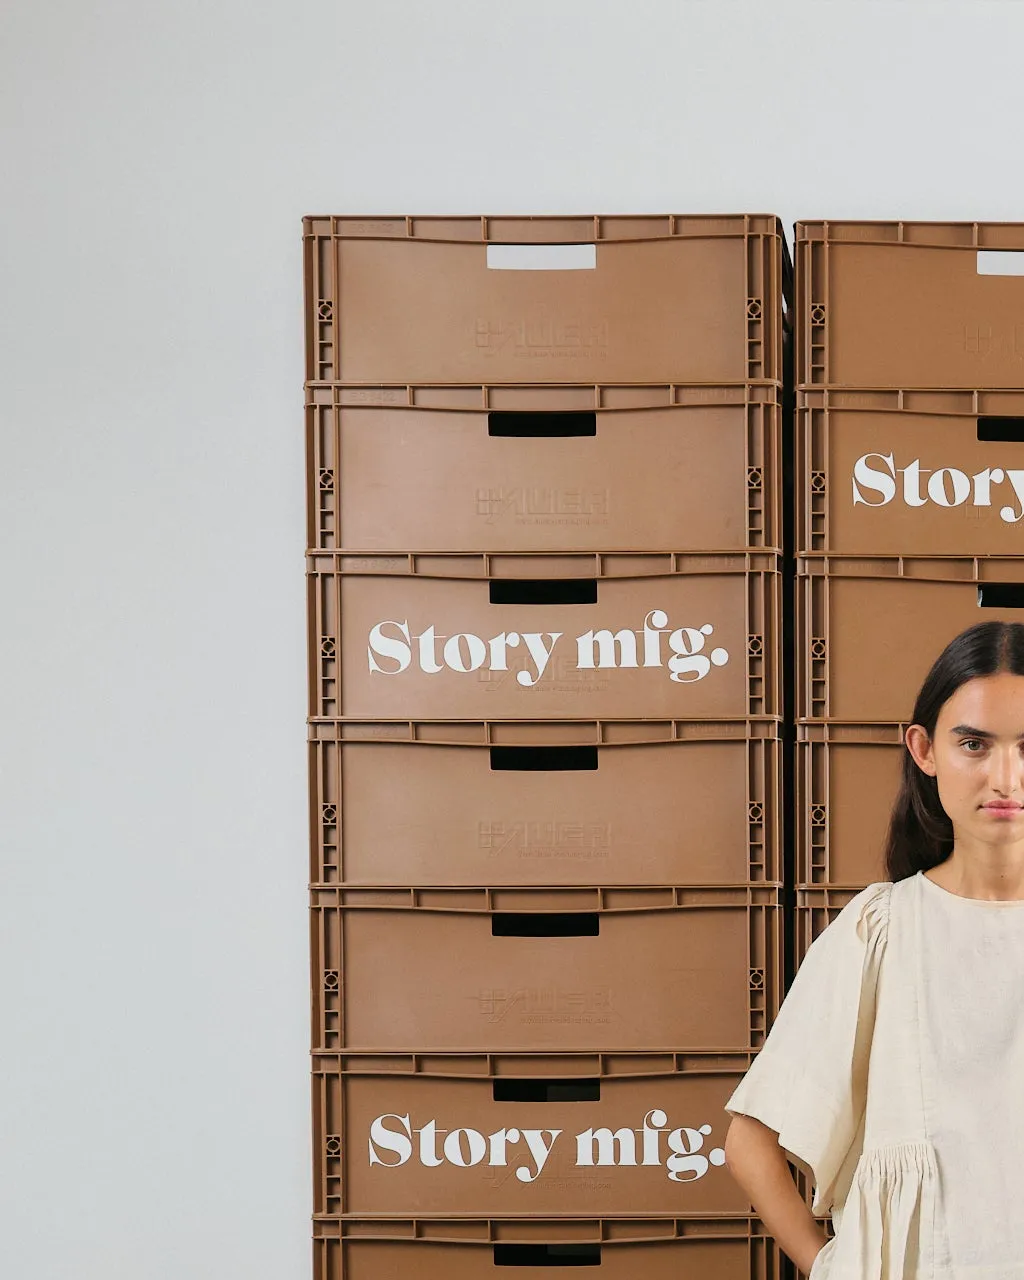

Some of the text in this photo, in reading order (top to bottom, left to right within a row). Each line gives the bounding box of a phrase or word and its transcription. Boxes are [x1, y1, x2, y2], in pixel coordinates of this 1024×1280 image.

[366, 609, 730, 687] Story mfg.
[367, 1108, 727, 1183] Story mfg.
